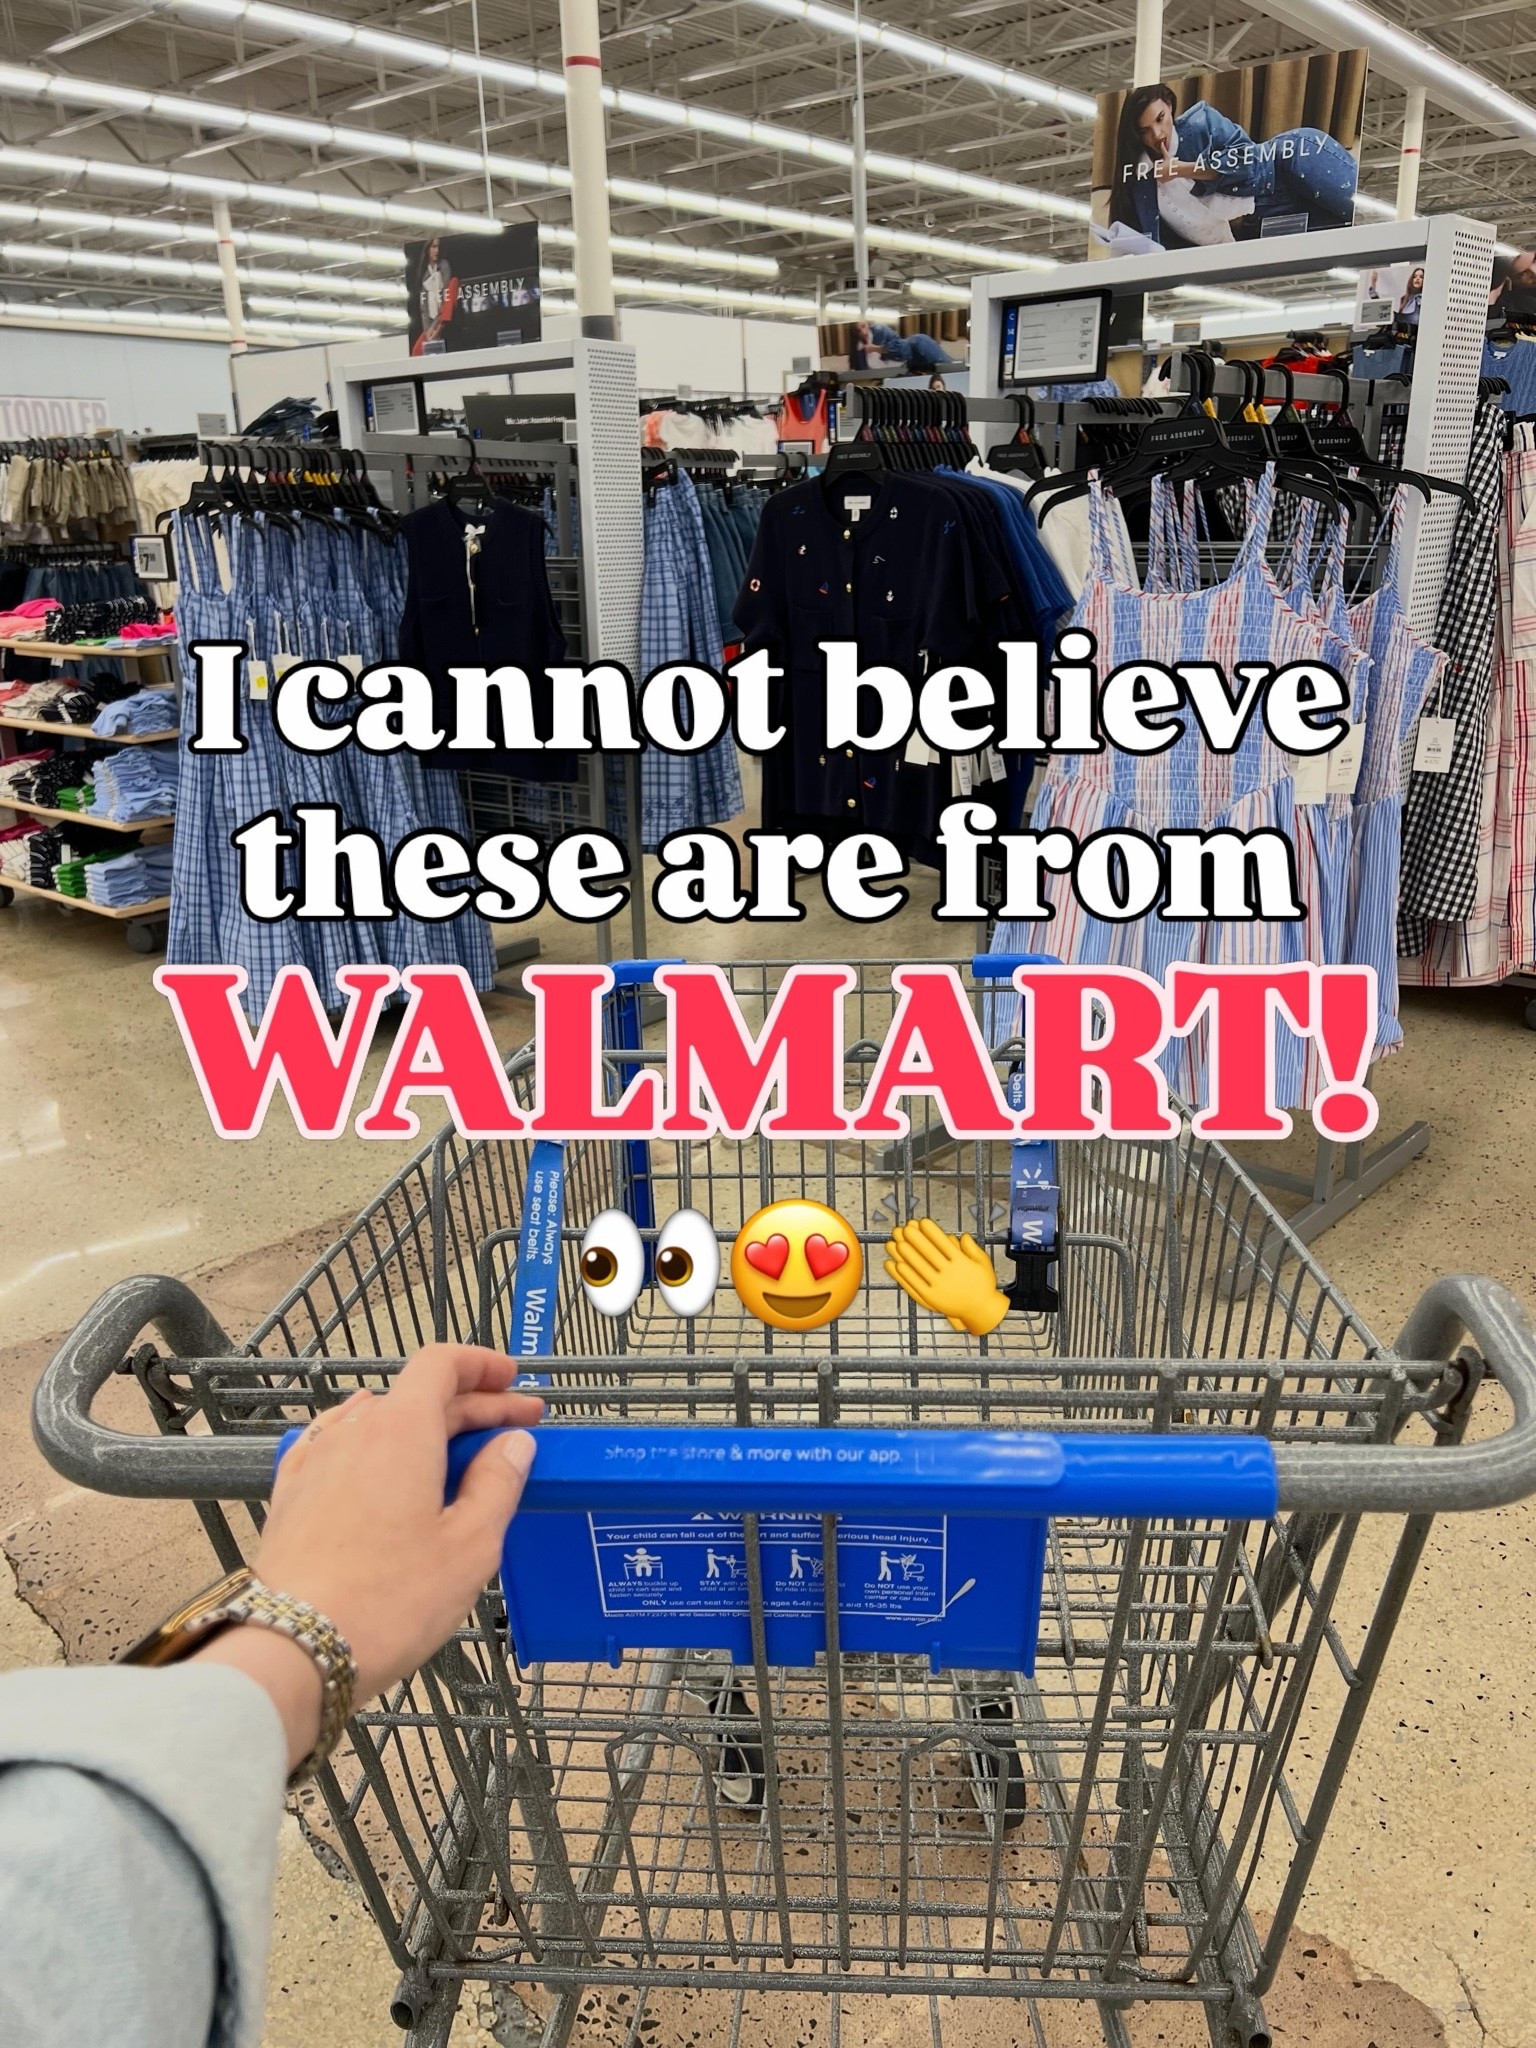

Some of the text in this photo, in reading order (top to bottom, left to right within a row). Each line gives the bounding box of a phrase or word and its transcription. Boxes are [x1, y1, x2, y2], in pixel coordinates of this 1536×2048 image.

[1122, 134, 1330, 183] FREE ASSEMBLY
[420, 277, 525, 305] FEE ASSEMBLY
[1150, 428, 1206, 442] FREE ASSEMBLY
[1277, 434, 1299, 442] EMBLY
[525, 1170, 544, 1263] use seat belts.
[543, 1170, 560, 1265] Please: Always
[519, 1288, 547, 1388] Walmrt
[730, 1444, 744, 1461] &
[747, 1448, 792, 1461] more
[796, 1445, 832, 1461] with
[837, 1449, 864, 1462] our
[606, 1533, 631, 1541] Your
[633, 1532, 658, 1540] child
[837, 1532, 870, 1541] erious
[872, 1533, 897, 1542] head
[670, 1581, 680, 1589] up
